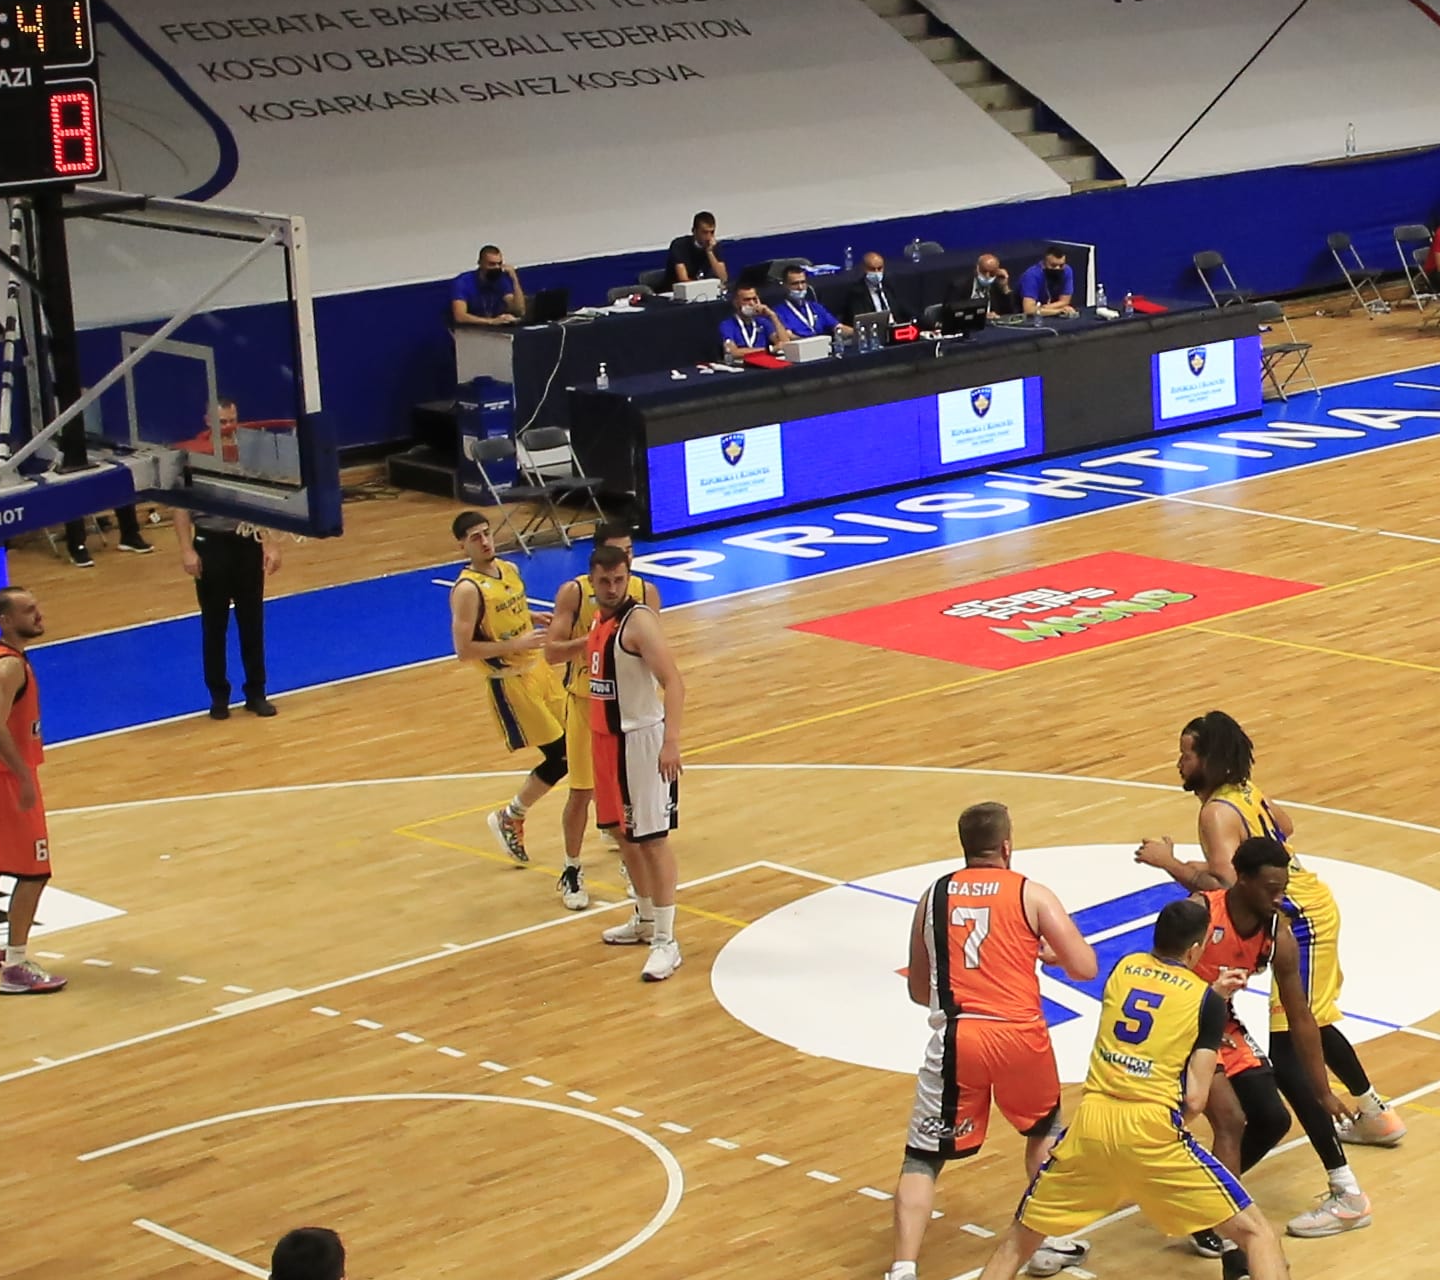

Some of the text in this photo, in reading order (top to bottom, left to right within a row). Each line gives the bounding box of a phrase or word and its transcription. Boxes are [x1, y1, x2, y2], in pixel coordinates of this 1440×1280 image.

[161, 11, 342, 45] FEDERATA
[343, 7, 368, 30] E
[199, 18, 753, 84] KOSOVO BASKETBALL FEDERATION
[239, 62, 706, 123] KOSARKASKI SAVEZ KOSOVA
[50, 92, 95, 174] 8
[591, 651, 599, 675] 8
[947, 881, 1000, 896] GASHI
[951, 906, 991, 969] 7
[1124, 964, 1193, 991] KASTRATI
[1113, 988, 1165, 1045] 5
